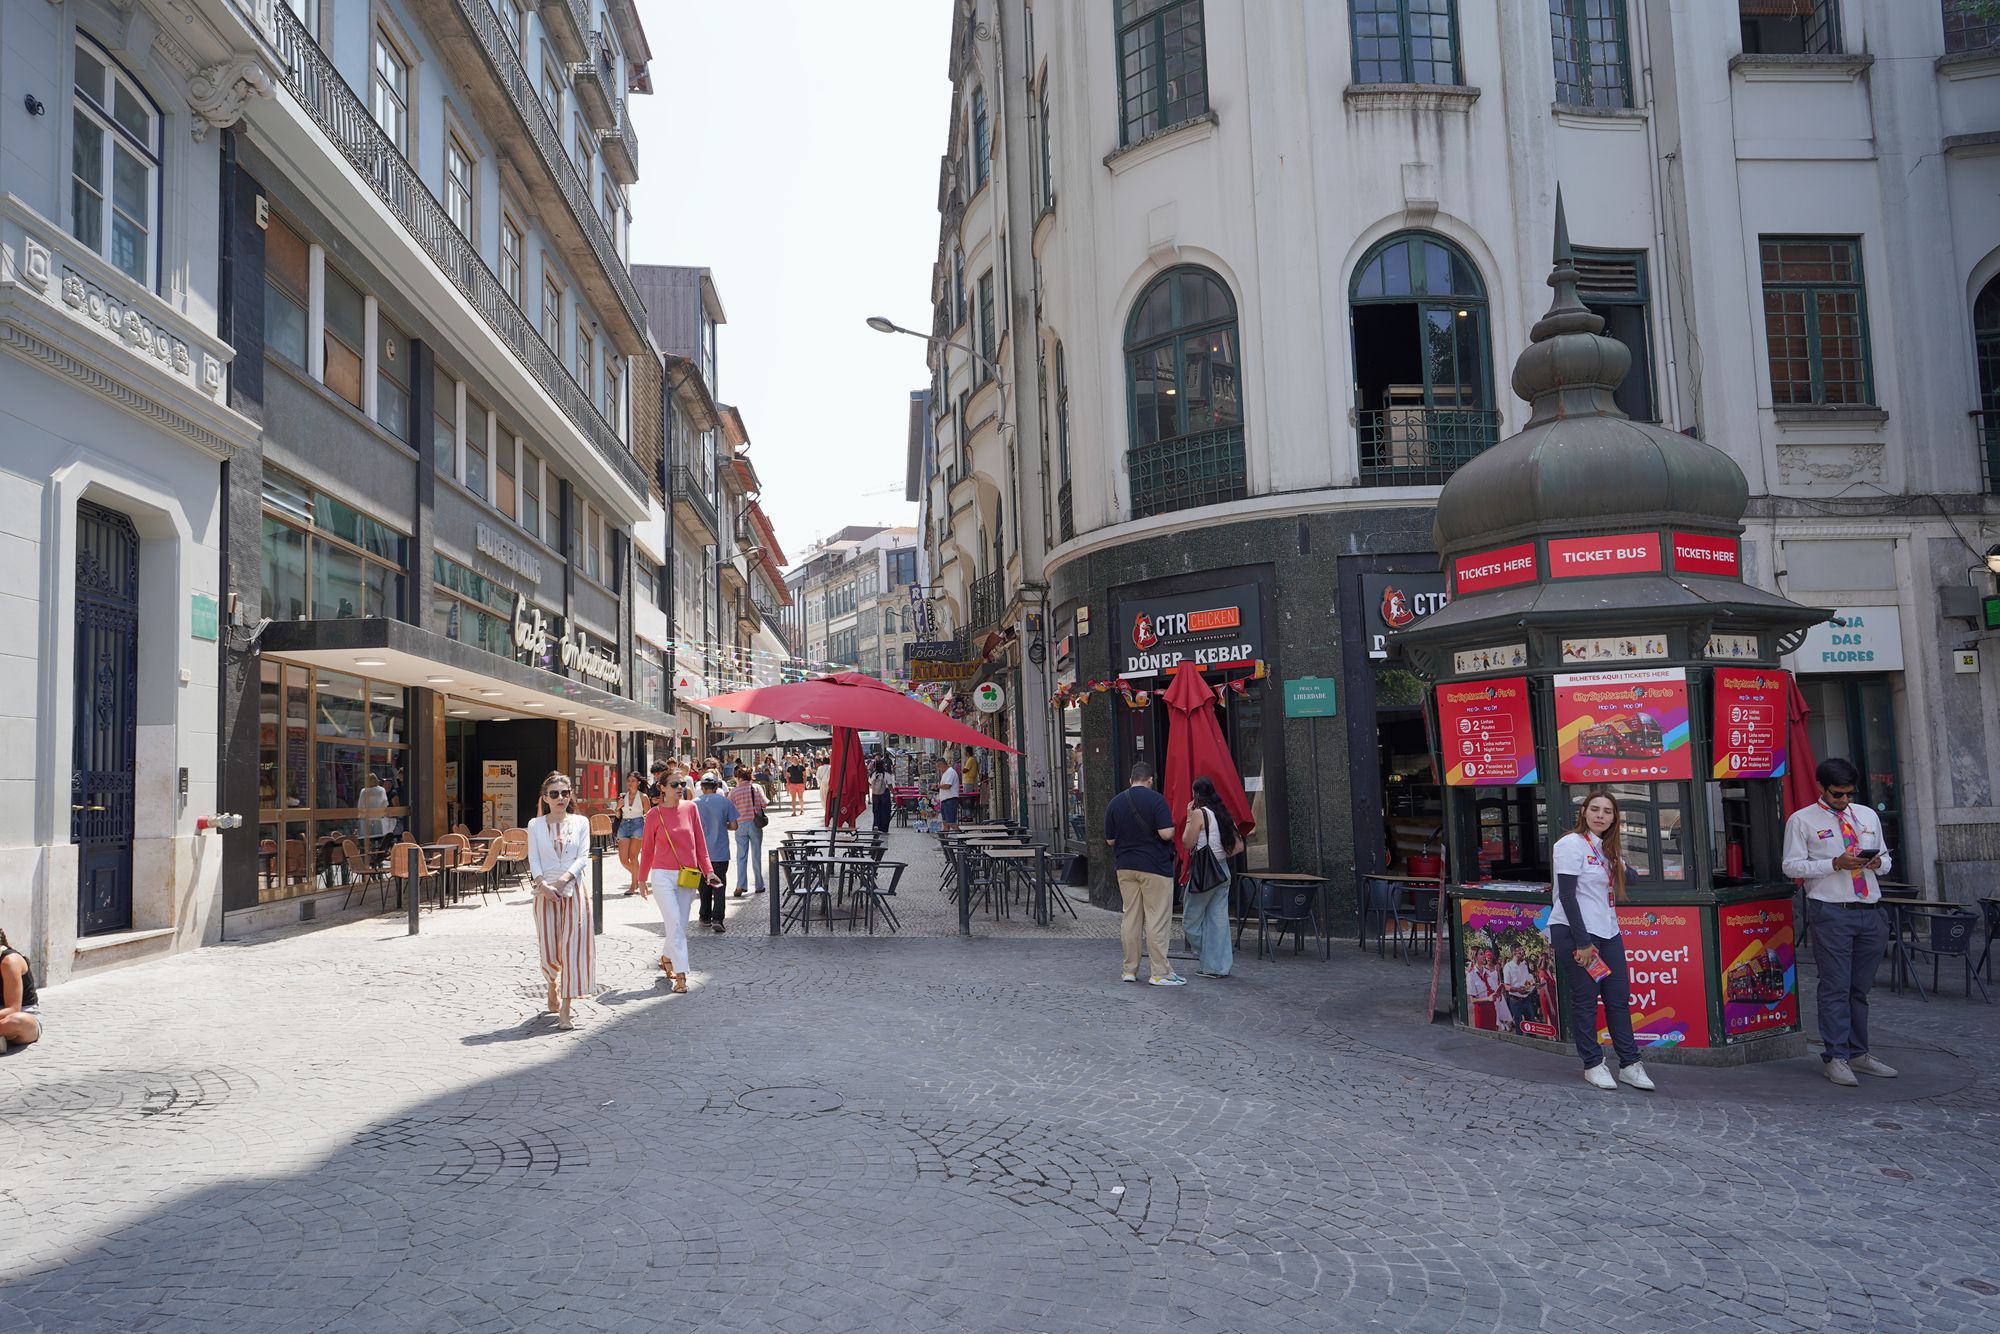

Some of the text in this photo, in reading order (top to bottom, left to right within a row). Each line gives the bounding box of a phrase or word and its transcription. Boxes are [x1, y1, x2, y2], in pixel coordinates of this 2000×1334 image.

[477, 522, 541, 584] BURGER KING
[1562, 546, 1647, 564] TICKET BUS
[1676, 546, 1735, 564] TICKETS HERE
[1459, 556, 1532, 581] TICKETS HERE
[1155, 613, 1187, 637] CTR
[1190, 611, 1235, 628] CHICKEN
[1832, 634, 1862, 646] DAS
[1128, 644, 1253, 672] DÖNER KEBAP
[1822, 651, 1874, 663] FLORES
[1498, 688, 1516, 698] Porto
[1572, 688, 1674, 702] CitySightseeing Porto
[1742, 710, 1748, 720] 2
[1472, 720, 1480, 730] 2
[575, 727, 610, 761] PORTO
[1742, 733, 1746, 744] 1
[1475, 742, 1480, 752] 1
[1478, 764, 1484, 774] 2
[1742, 756, 1748, 767] 2
[1661, 915, 1686, 926] Porto
[1624, 946, 1689, 962] cover!
[1629, 967, 1678, 984] lore!
[1628, 989, 1656, 1010] oy!
